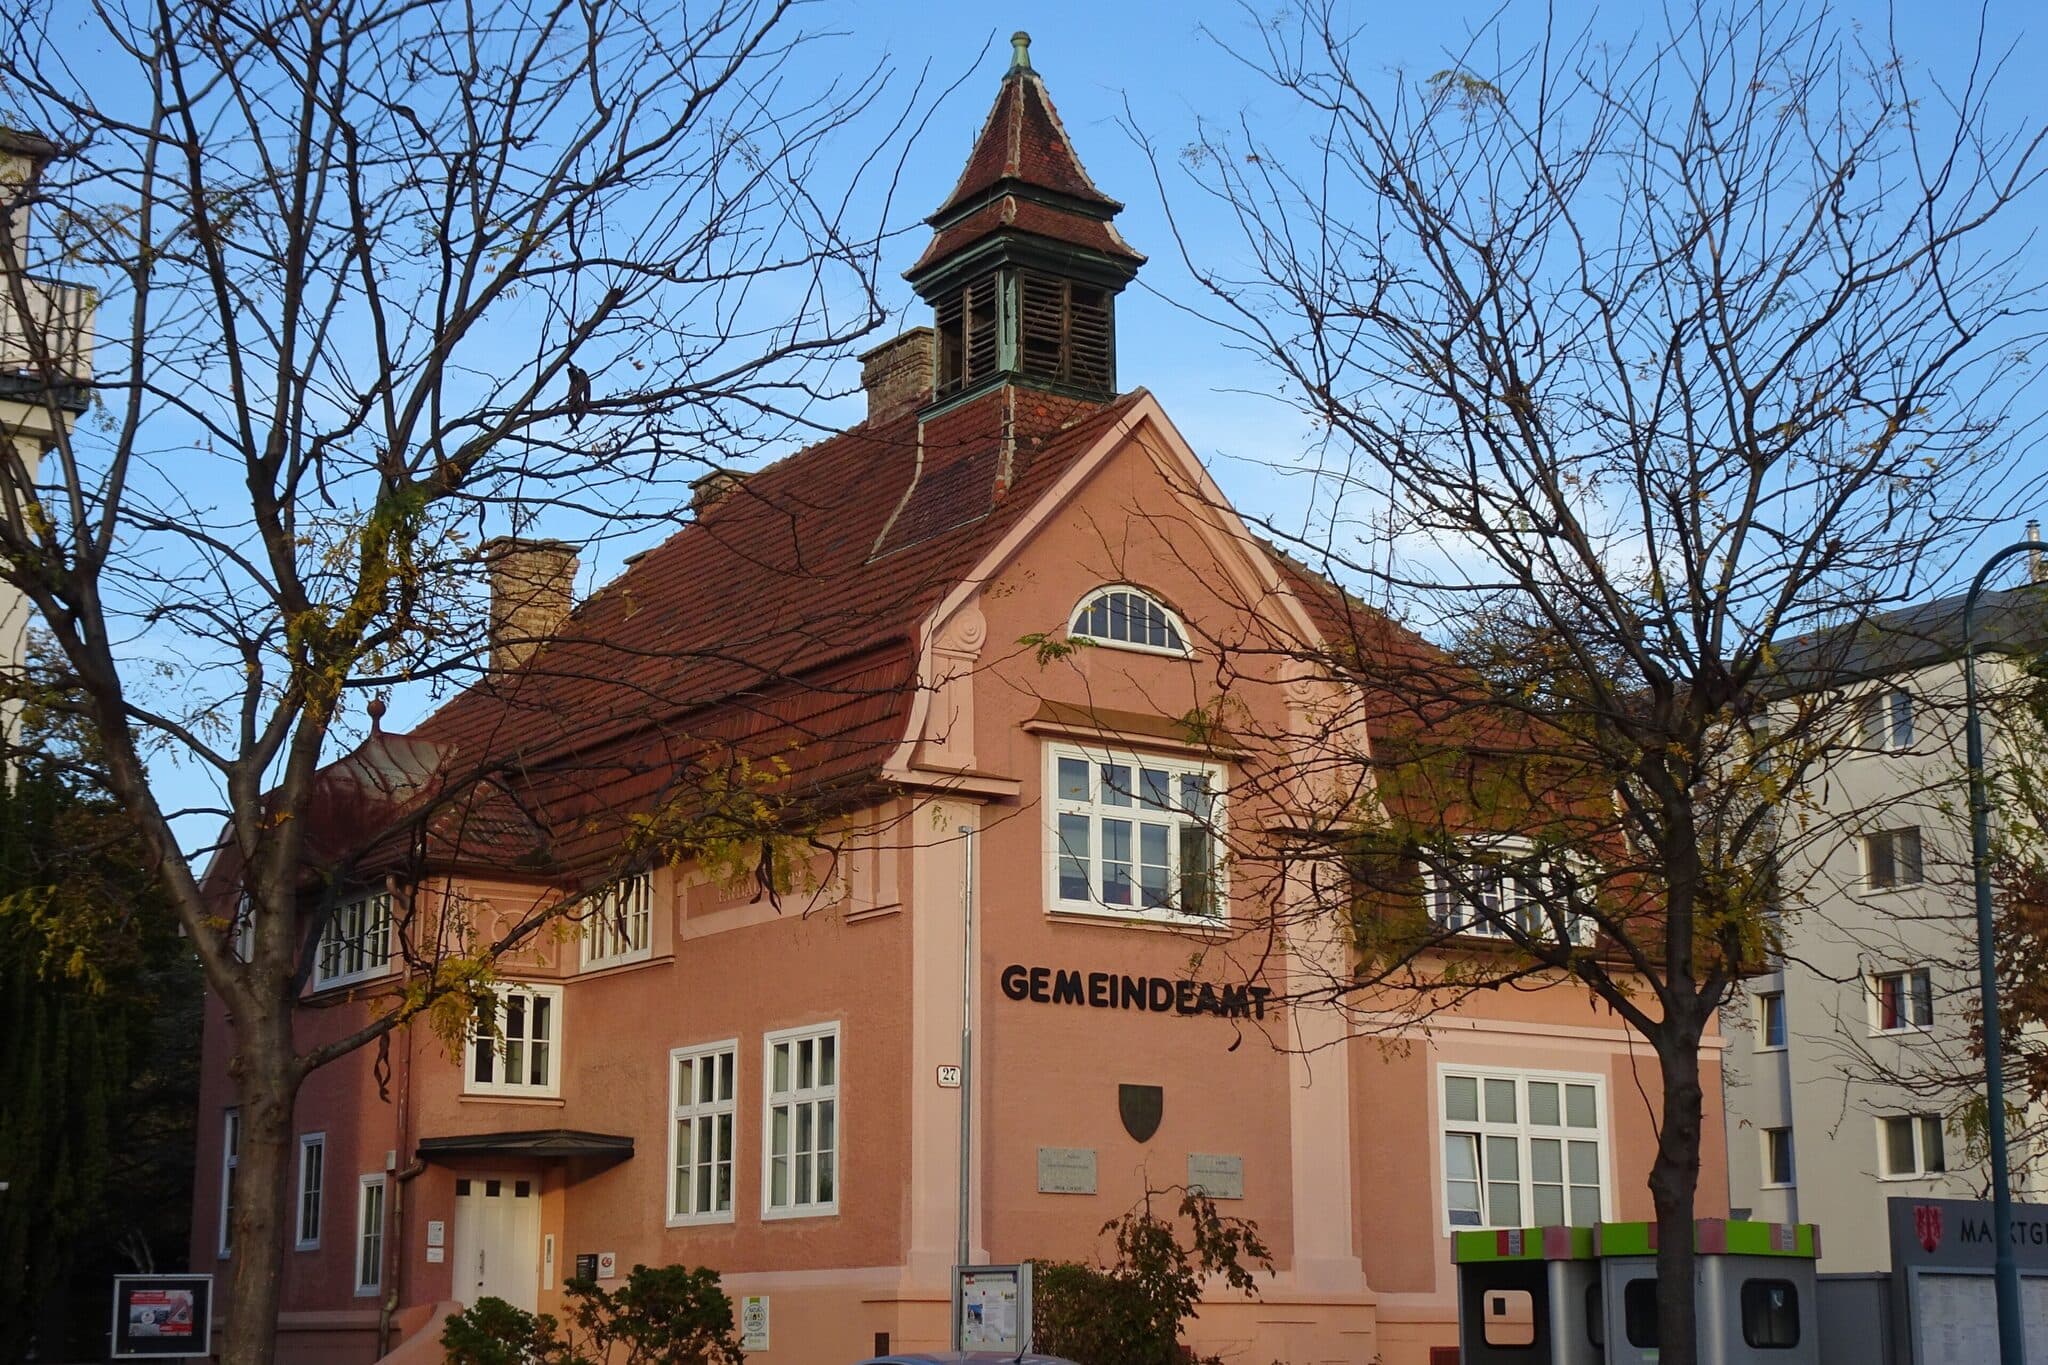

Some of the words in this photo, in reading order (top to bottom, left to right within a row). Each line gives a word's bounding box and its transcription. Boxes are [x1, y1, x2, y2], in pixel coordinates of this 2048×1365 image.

[1001, 965, 1270, 1020] GEMEINDEAMT
[943, 1067, 956, 1081] 27
[1960, 1217, 2048, 1245] MAKTG
